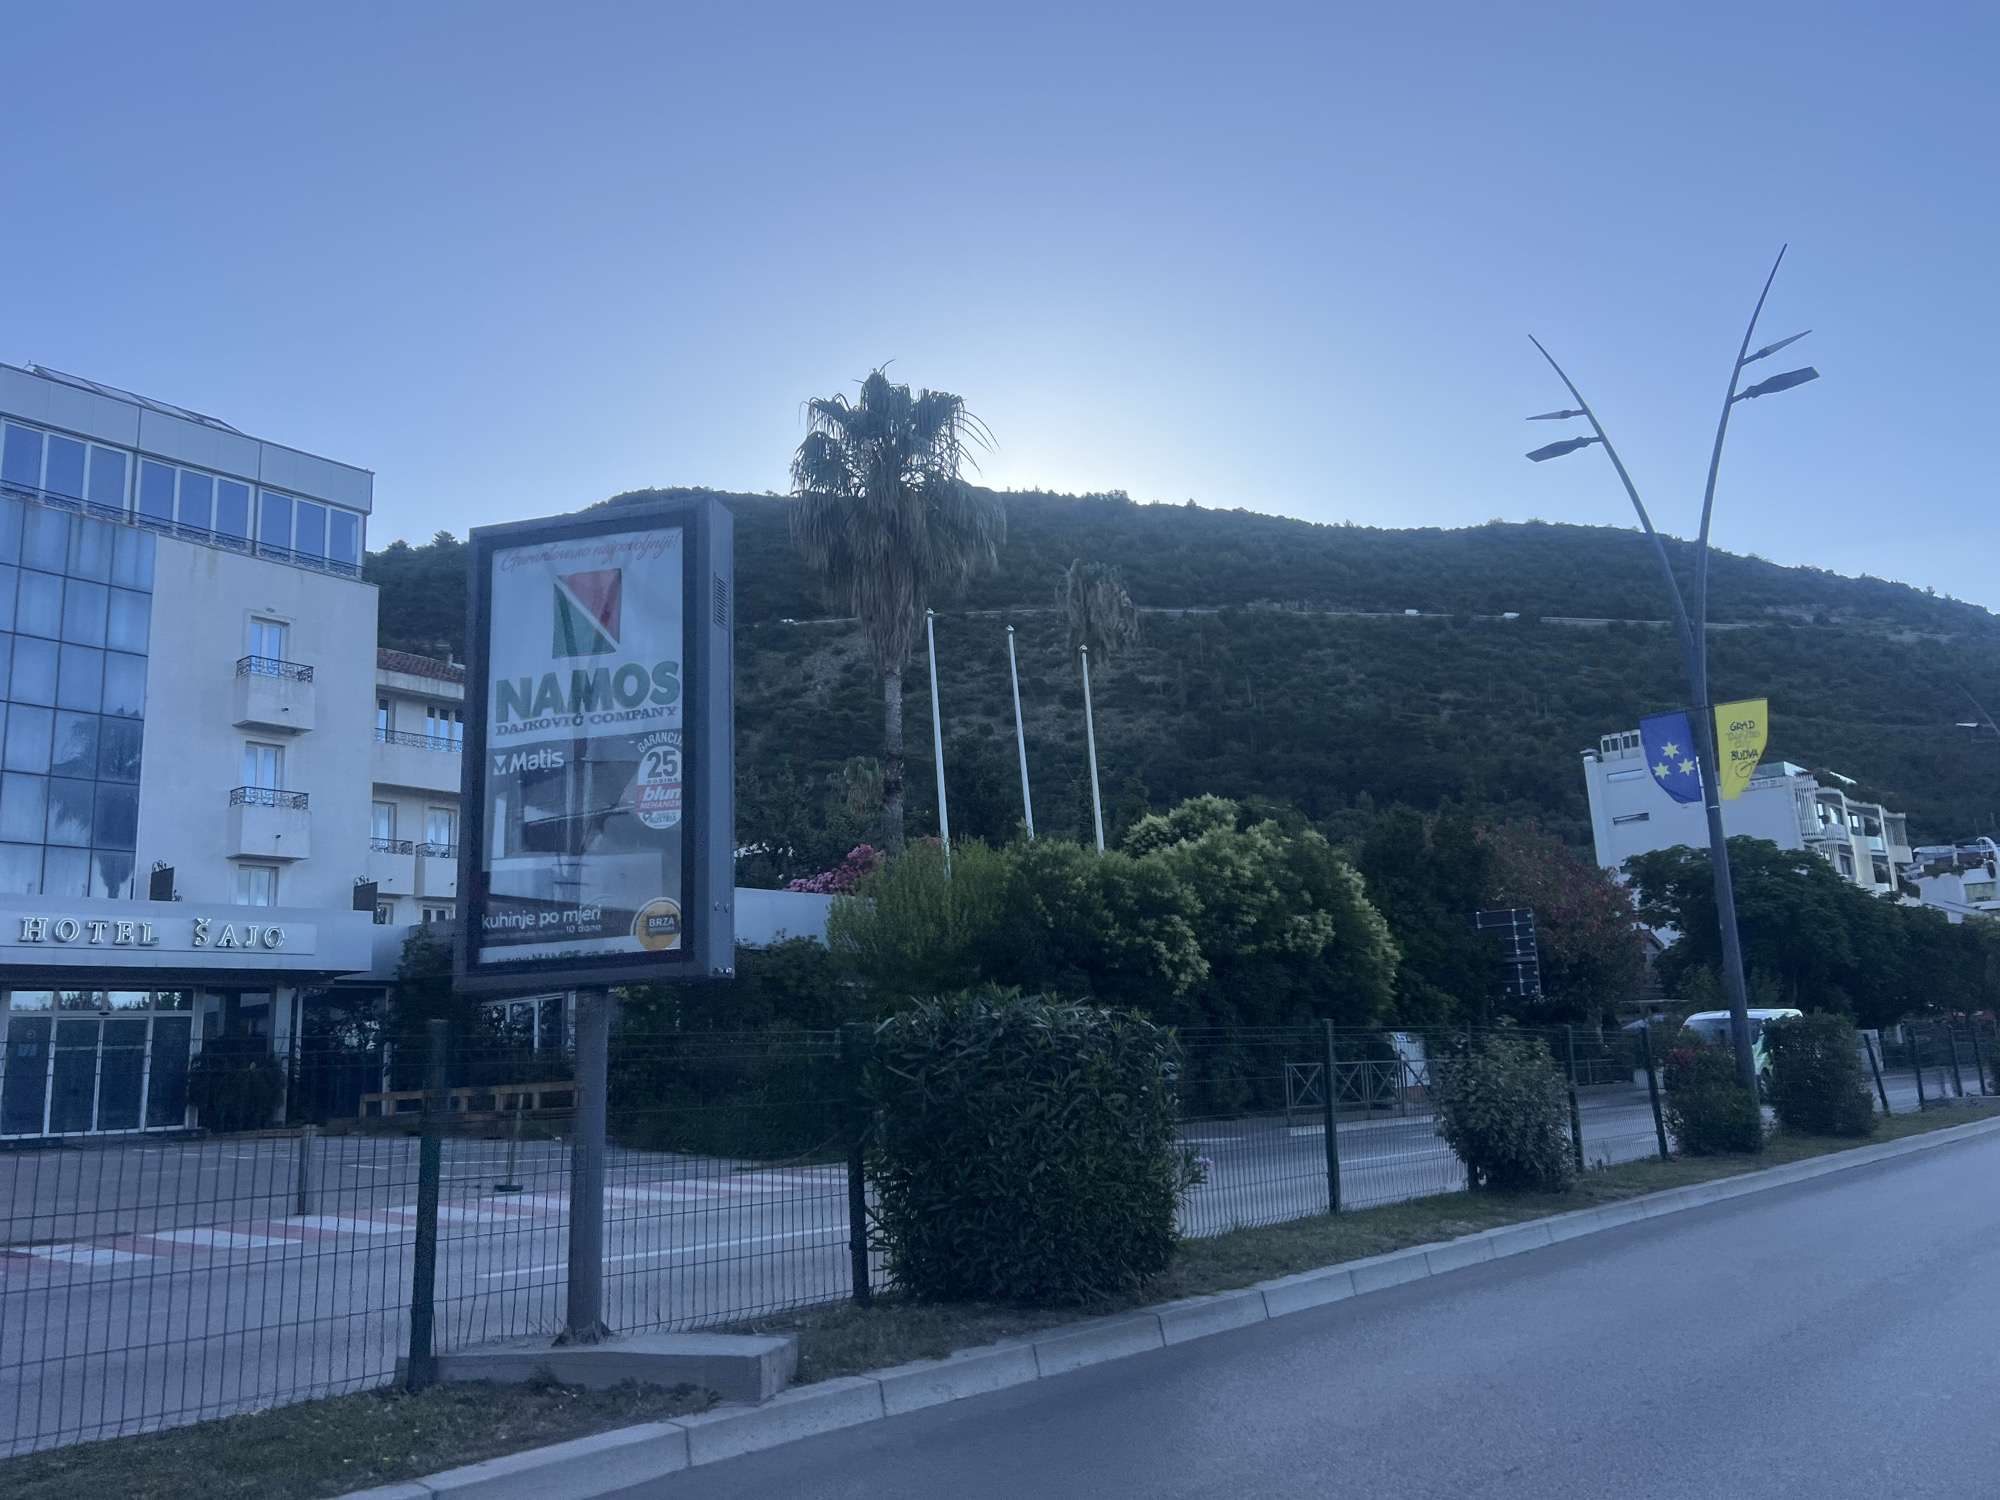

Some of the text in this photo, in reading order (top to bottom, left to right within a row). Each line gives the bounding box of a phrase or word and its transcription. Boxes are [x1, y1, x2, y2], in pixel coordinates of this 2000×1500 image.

[496, 660, 681, 723] NAMOS
[589, 706, 677, 725] COMPANY
[1729, 720, 1756, 732] GRAD
[509, 749, 564, 773] Matis
[646, 750, 678, 779] 25
[1730, 748, 1759, 761] BUDVA
[482, 905, 602, 930] kuhinje po mjeri
[649, 916, 675, 927] BRZA
[19, 917, 287, 949] HOTEL ŠAJO
